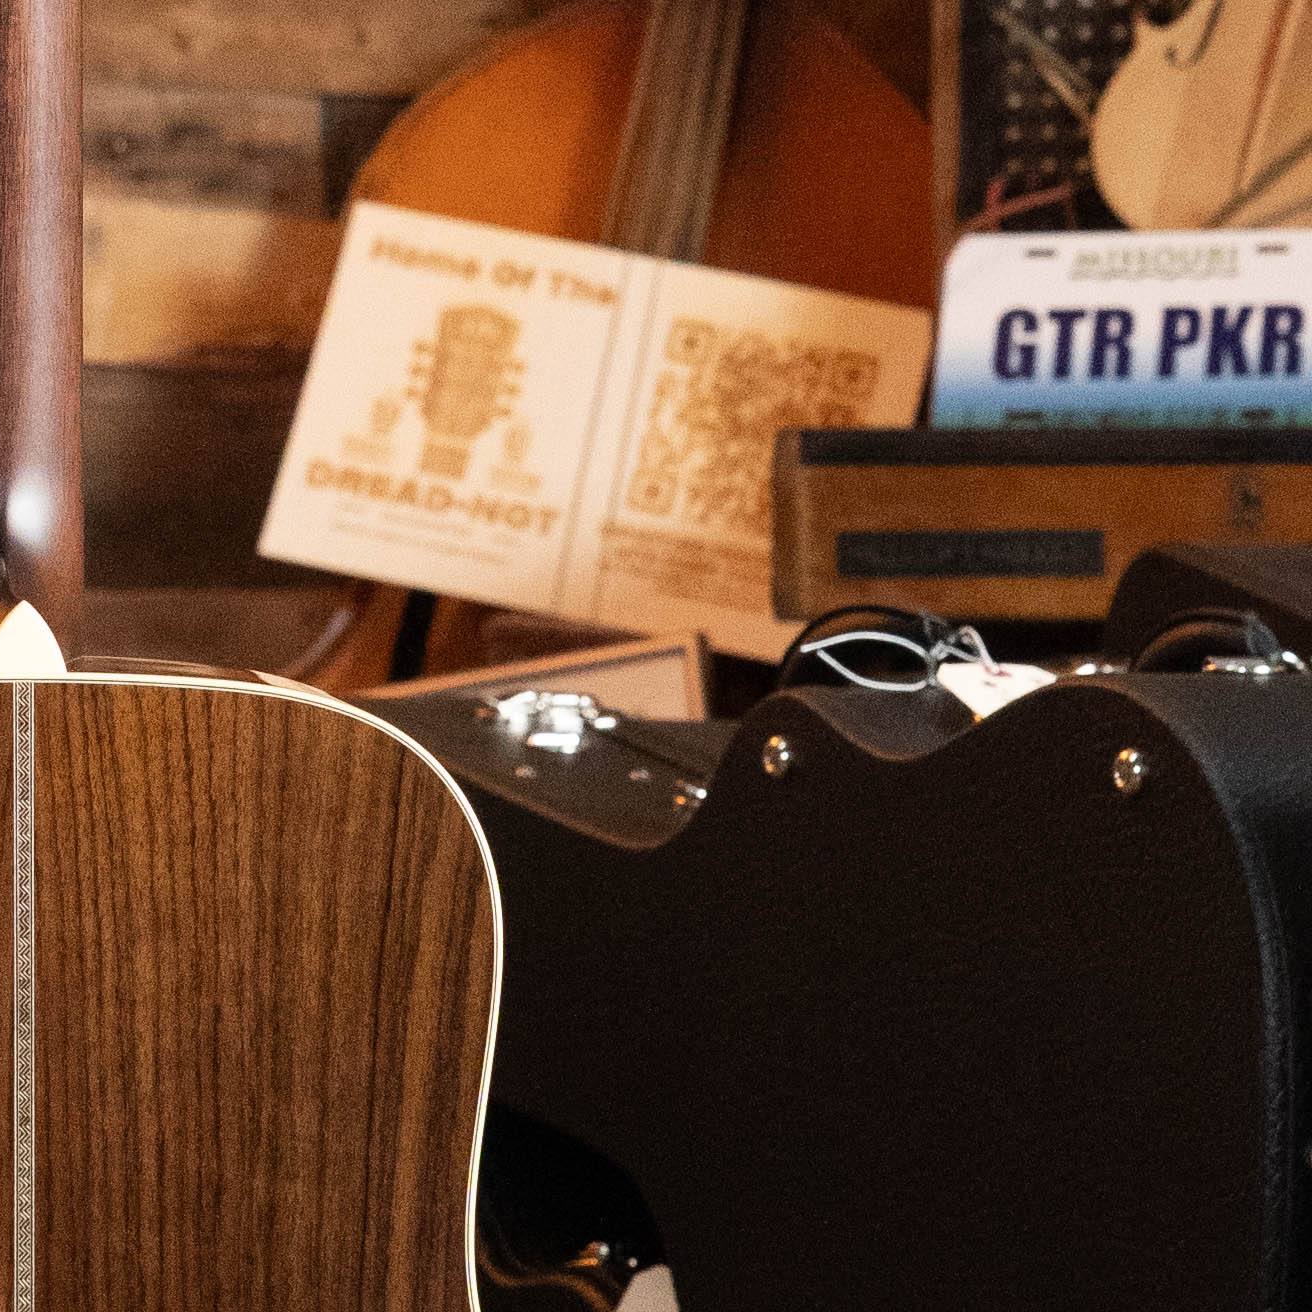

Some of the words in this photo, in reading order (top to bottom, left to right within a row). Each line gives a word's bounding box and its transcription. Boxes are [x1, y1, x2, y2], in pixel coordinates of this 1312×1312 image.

[370, 238, 480, 280] Home
[993, 306, 1135, 383] GTR
[1158, 304, 1305, 380] PKR
[305, 458, 563, 537] DREAD-NOT
